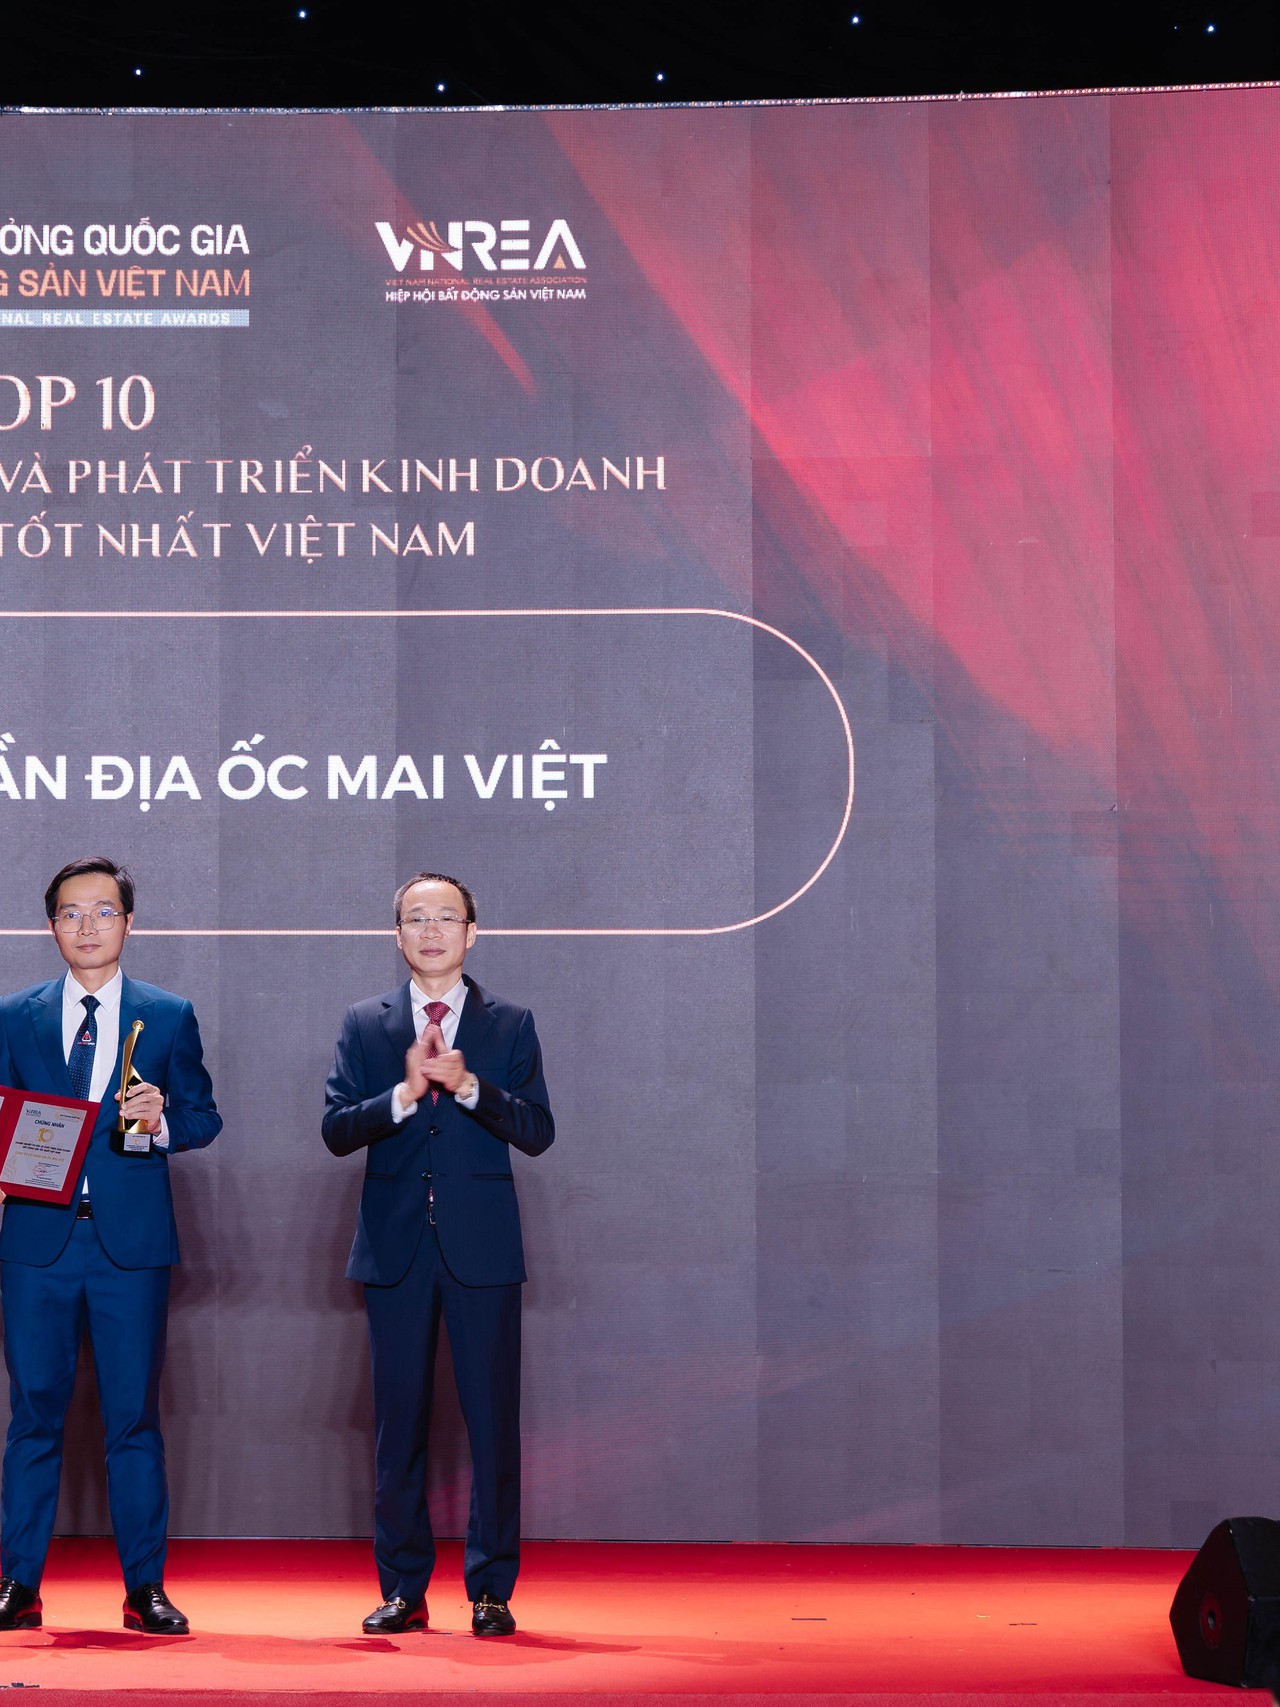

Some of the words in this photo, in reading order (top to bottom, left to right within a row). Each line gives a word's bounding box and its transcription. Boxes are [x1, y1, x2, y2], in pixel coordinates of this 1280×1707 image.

[83, 216, 181, 257] QUỐC
[190, 223, 250, 256] GIA
[374, 218, 588, 273] VNREA
[18, 261, 87, 297] SẢN
[95, 264, 167, 300] VIỆT
[175, 268, 251, 297] NAM
[385, 288, 411, 303] HIỆP
[413, 288, 435, 303] HỘI
[438, 286, 459, 301] BẤT
[460, 287, 500, 303] ĐỘNG
[503, 286, 527, 300] SẢN
[529, 286, 554, 302] VIỆT
[556, 288, 587, 300] NAM
[42, 313, 84, 326] REAL
[93, 313, 154, 326] ESTATE
[161, 313, 231, 326] AWARDS
[95, 375, 156, 431] 10
[68, 452, 191, 494] PHÁT
[205, 444, 346, 494] TRIỂN
[361, 458, 479, 493] KINH
[495, 456, 666, 492] DOANH
[96, 510, 232, 558] NHẤT
[245, 514, 356, 565] VIỆT
[370, 521, 475, 557] NAM
[84, 754, 202, 812] ĐỊA
[217, 733, 309, 801] ỐC
[327, 754, 445, 800] MAI
[463, 738, 609, 812] VIỆT
